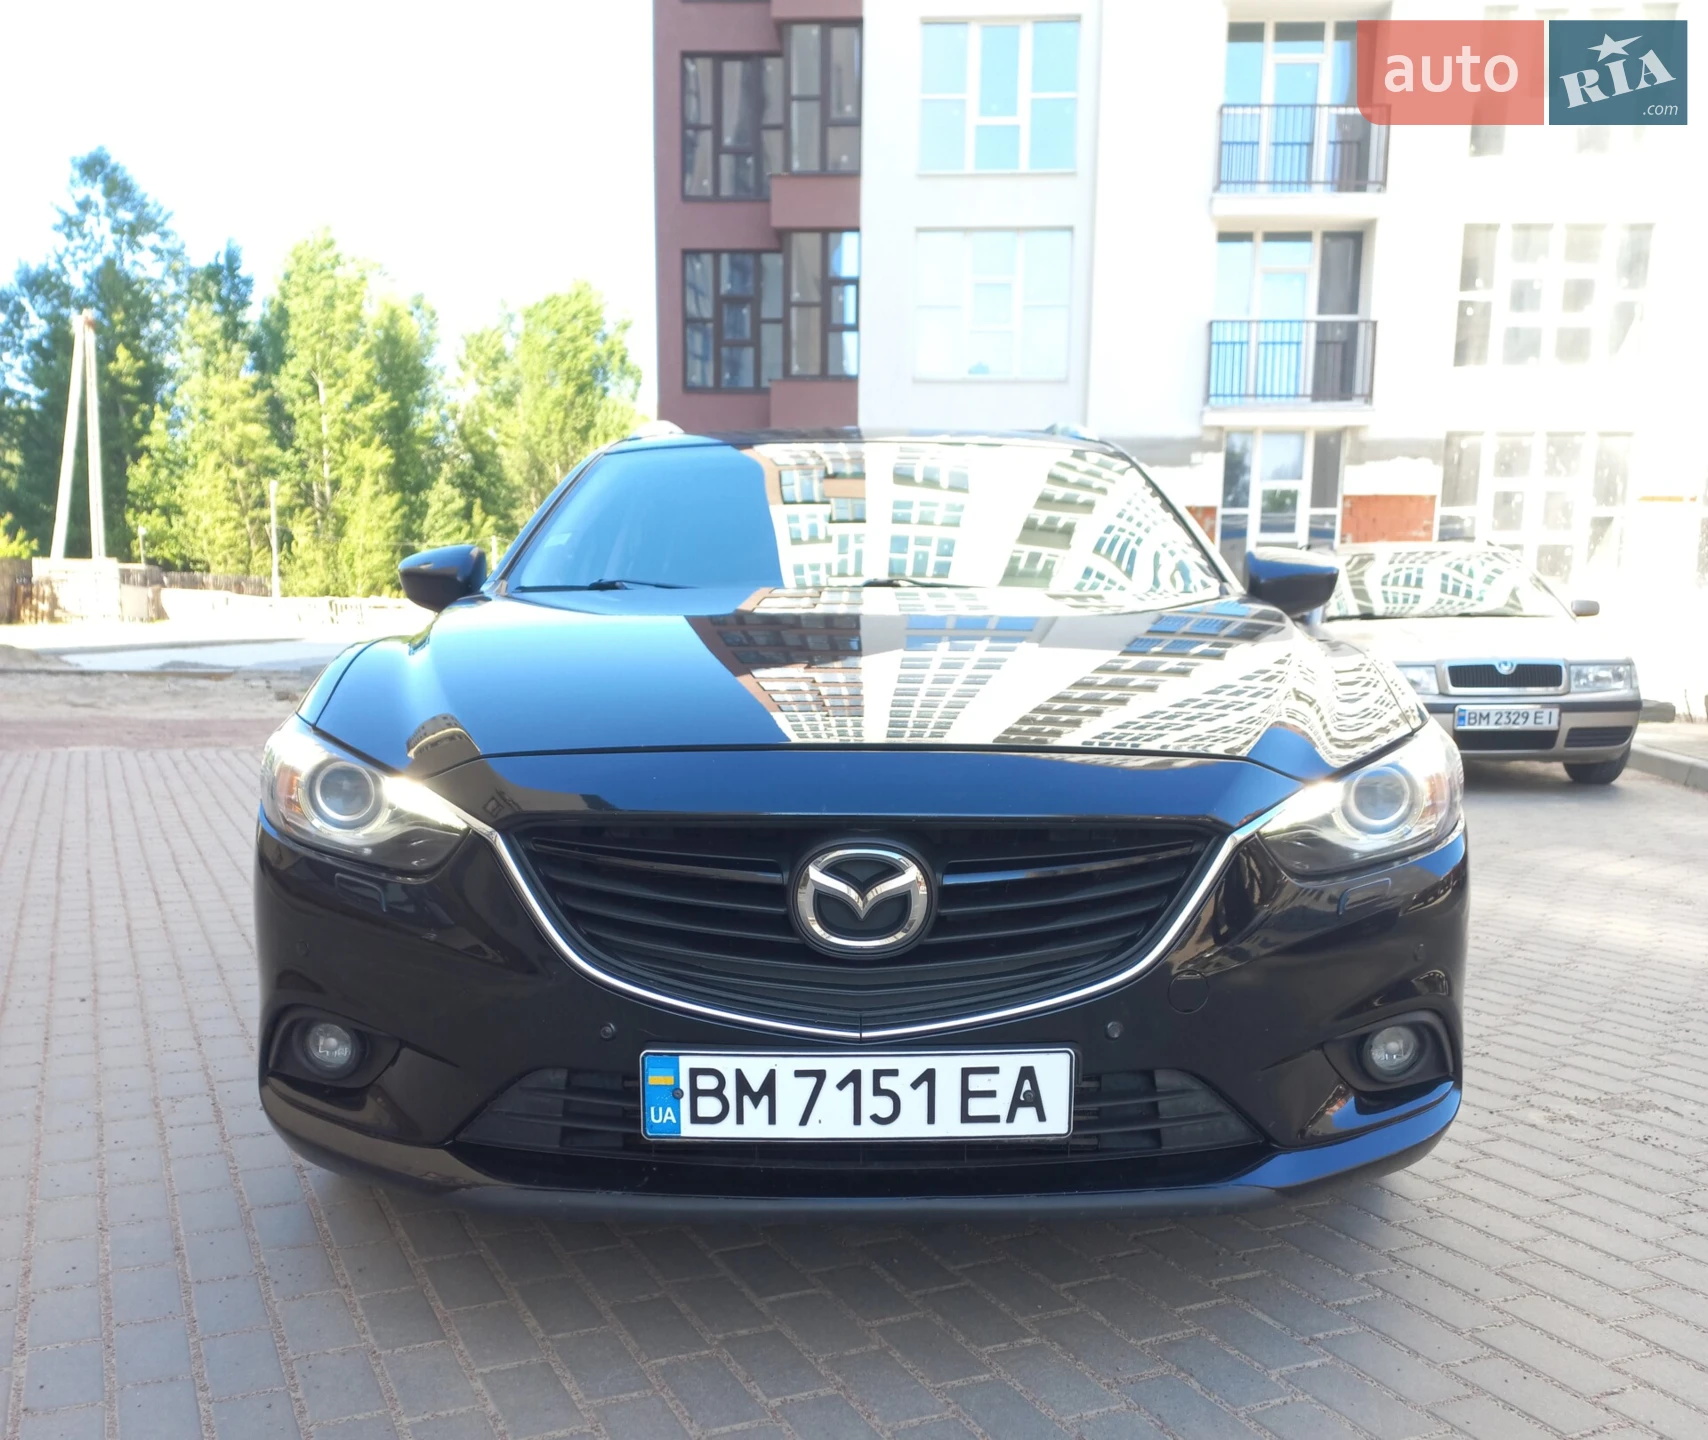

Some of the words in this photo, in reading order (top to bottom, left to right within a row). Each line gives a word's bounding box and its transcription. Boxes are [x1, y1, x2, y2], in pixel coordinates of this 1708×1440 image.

[1467, 711, 1490, 726] BM
[1494, 711, 1530, 725] 2329
[1533, 711, 1552, 725] EI
[688, 1067, 777, 1125] BM
[793, 1067, 936, 1126] 7151
[960, 1066, 1047, 1123] EA
[650, 1106, 677, 1124] UA
